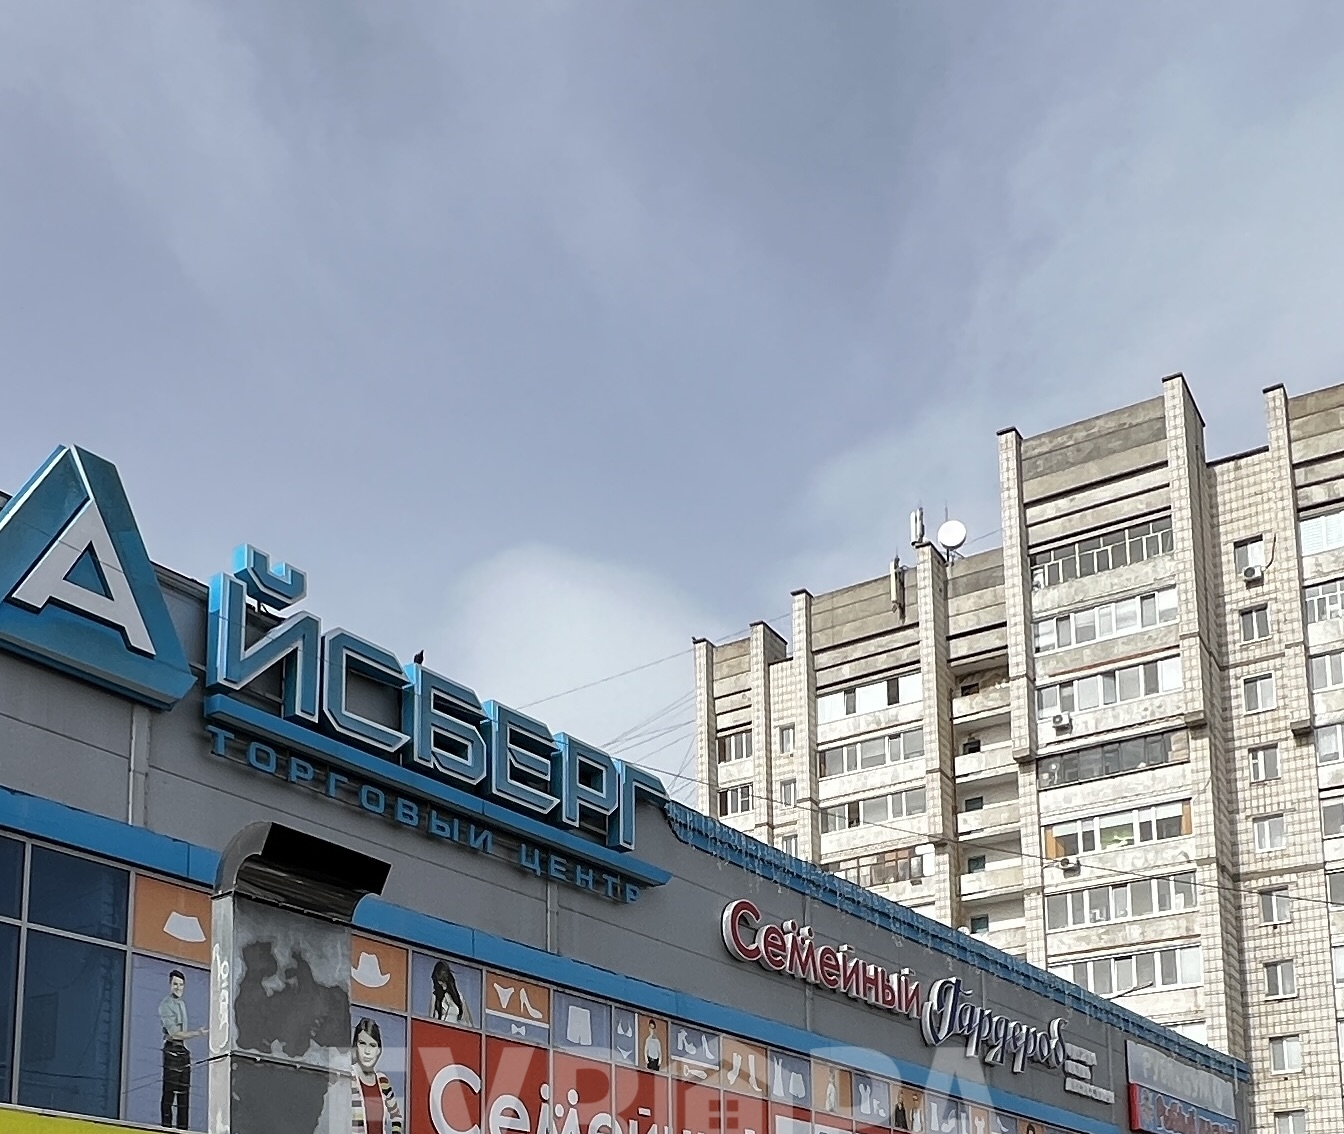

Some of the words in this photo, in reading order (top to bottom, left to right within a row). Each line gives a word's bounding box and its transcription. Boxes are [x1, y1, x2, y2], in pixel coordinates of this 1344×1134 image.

[518, 842, 641, 904] ЦЕНТР
[721, 899, 924, 1019] Семейный
[920, 976, 1069, 1074] Гардероб
